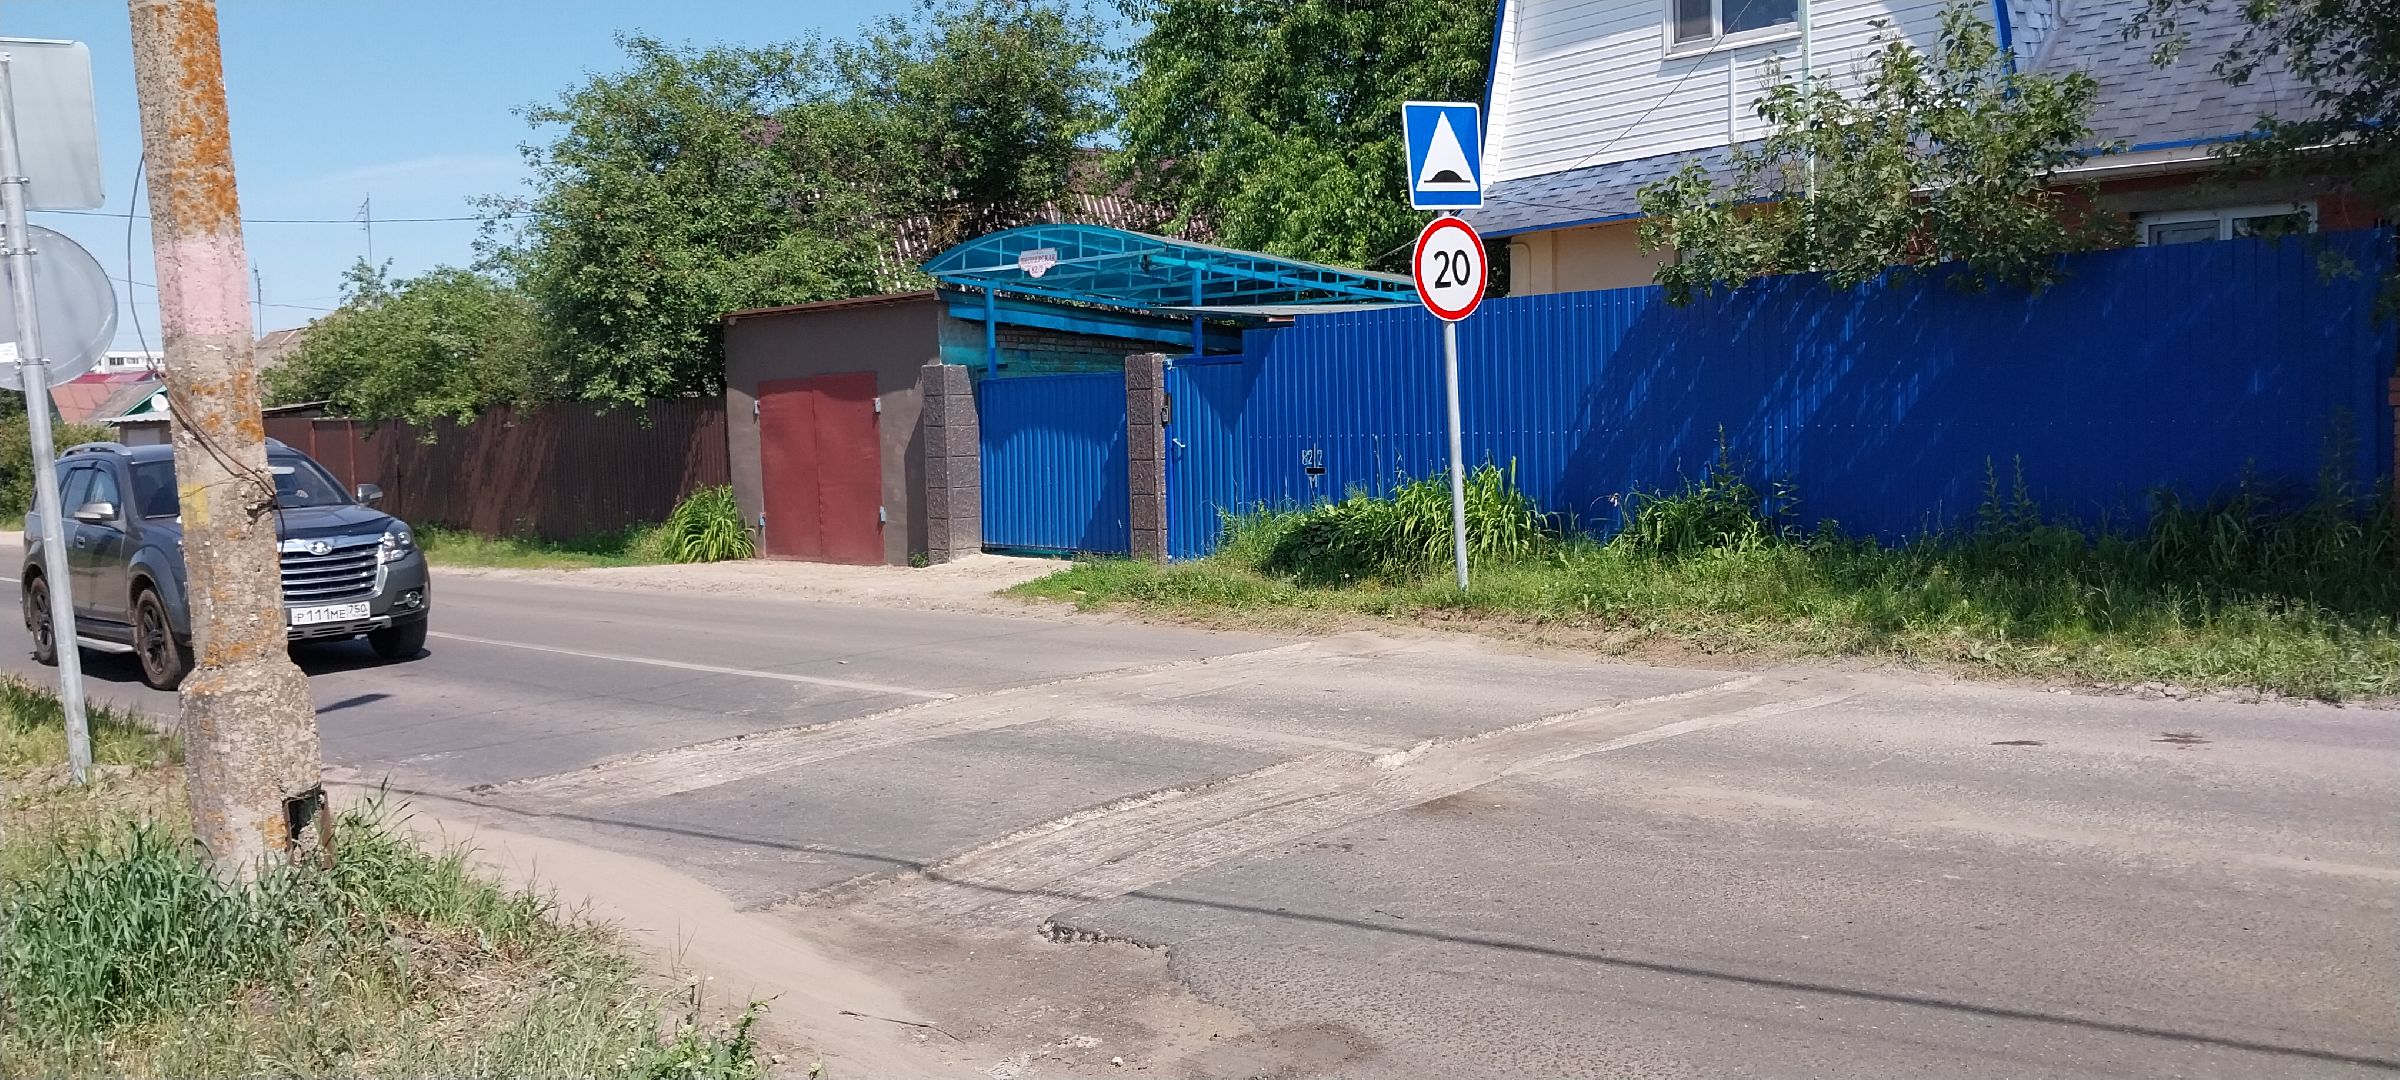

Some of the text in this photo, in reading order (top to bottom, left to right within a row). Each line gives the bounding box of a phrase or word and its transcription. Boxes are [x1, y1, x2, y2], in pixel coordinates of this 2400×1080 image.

[1434, 250, 1471, 288] 20
[297, 604, 367, 622] Р111МЕ 750
